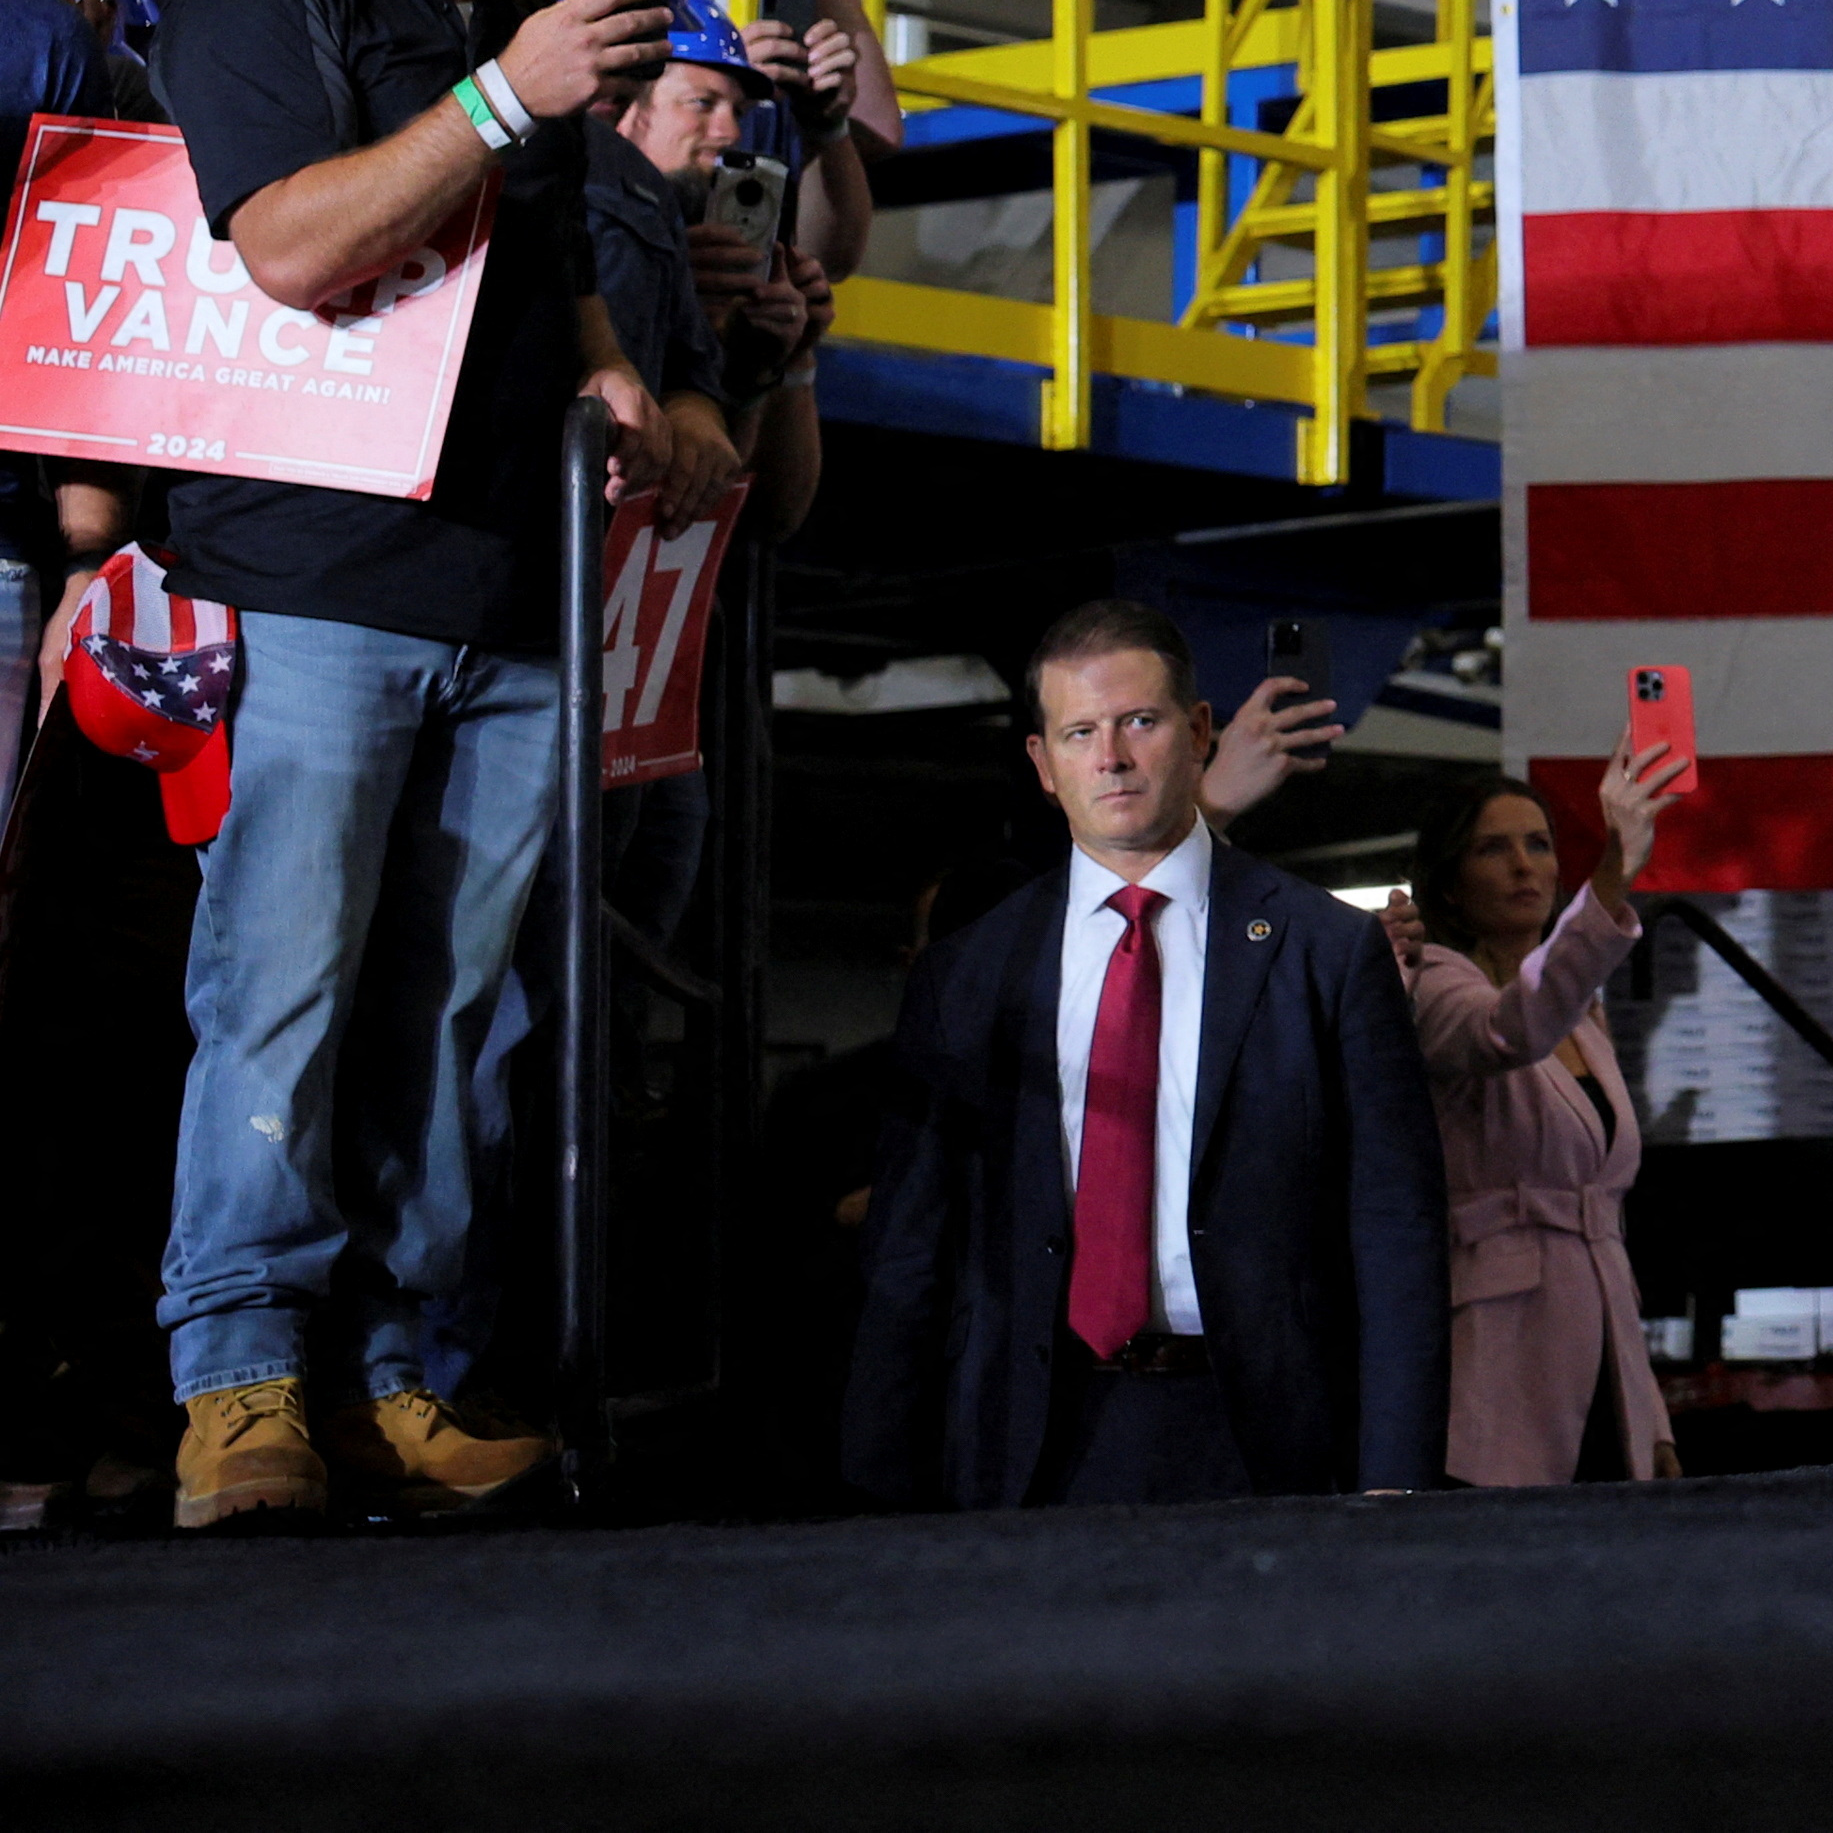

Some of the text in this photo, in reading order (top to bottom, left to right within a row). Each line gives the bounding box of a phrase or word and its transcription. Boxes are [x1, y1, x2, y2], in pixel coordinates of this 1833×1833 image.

[36, 199, 448, 315] TRUP
[26, 345, 391, 405] MAKE AMERICA GREAT AGAIN!
[64, 280, 384, 377] VANCE
[145, 432, 227, 463] 2024
[602, 519, 719, 733] 47
